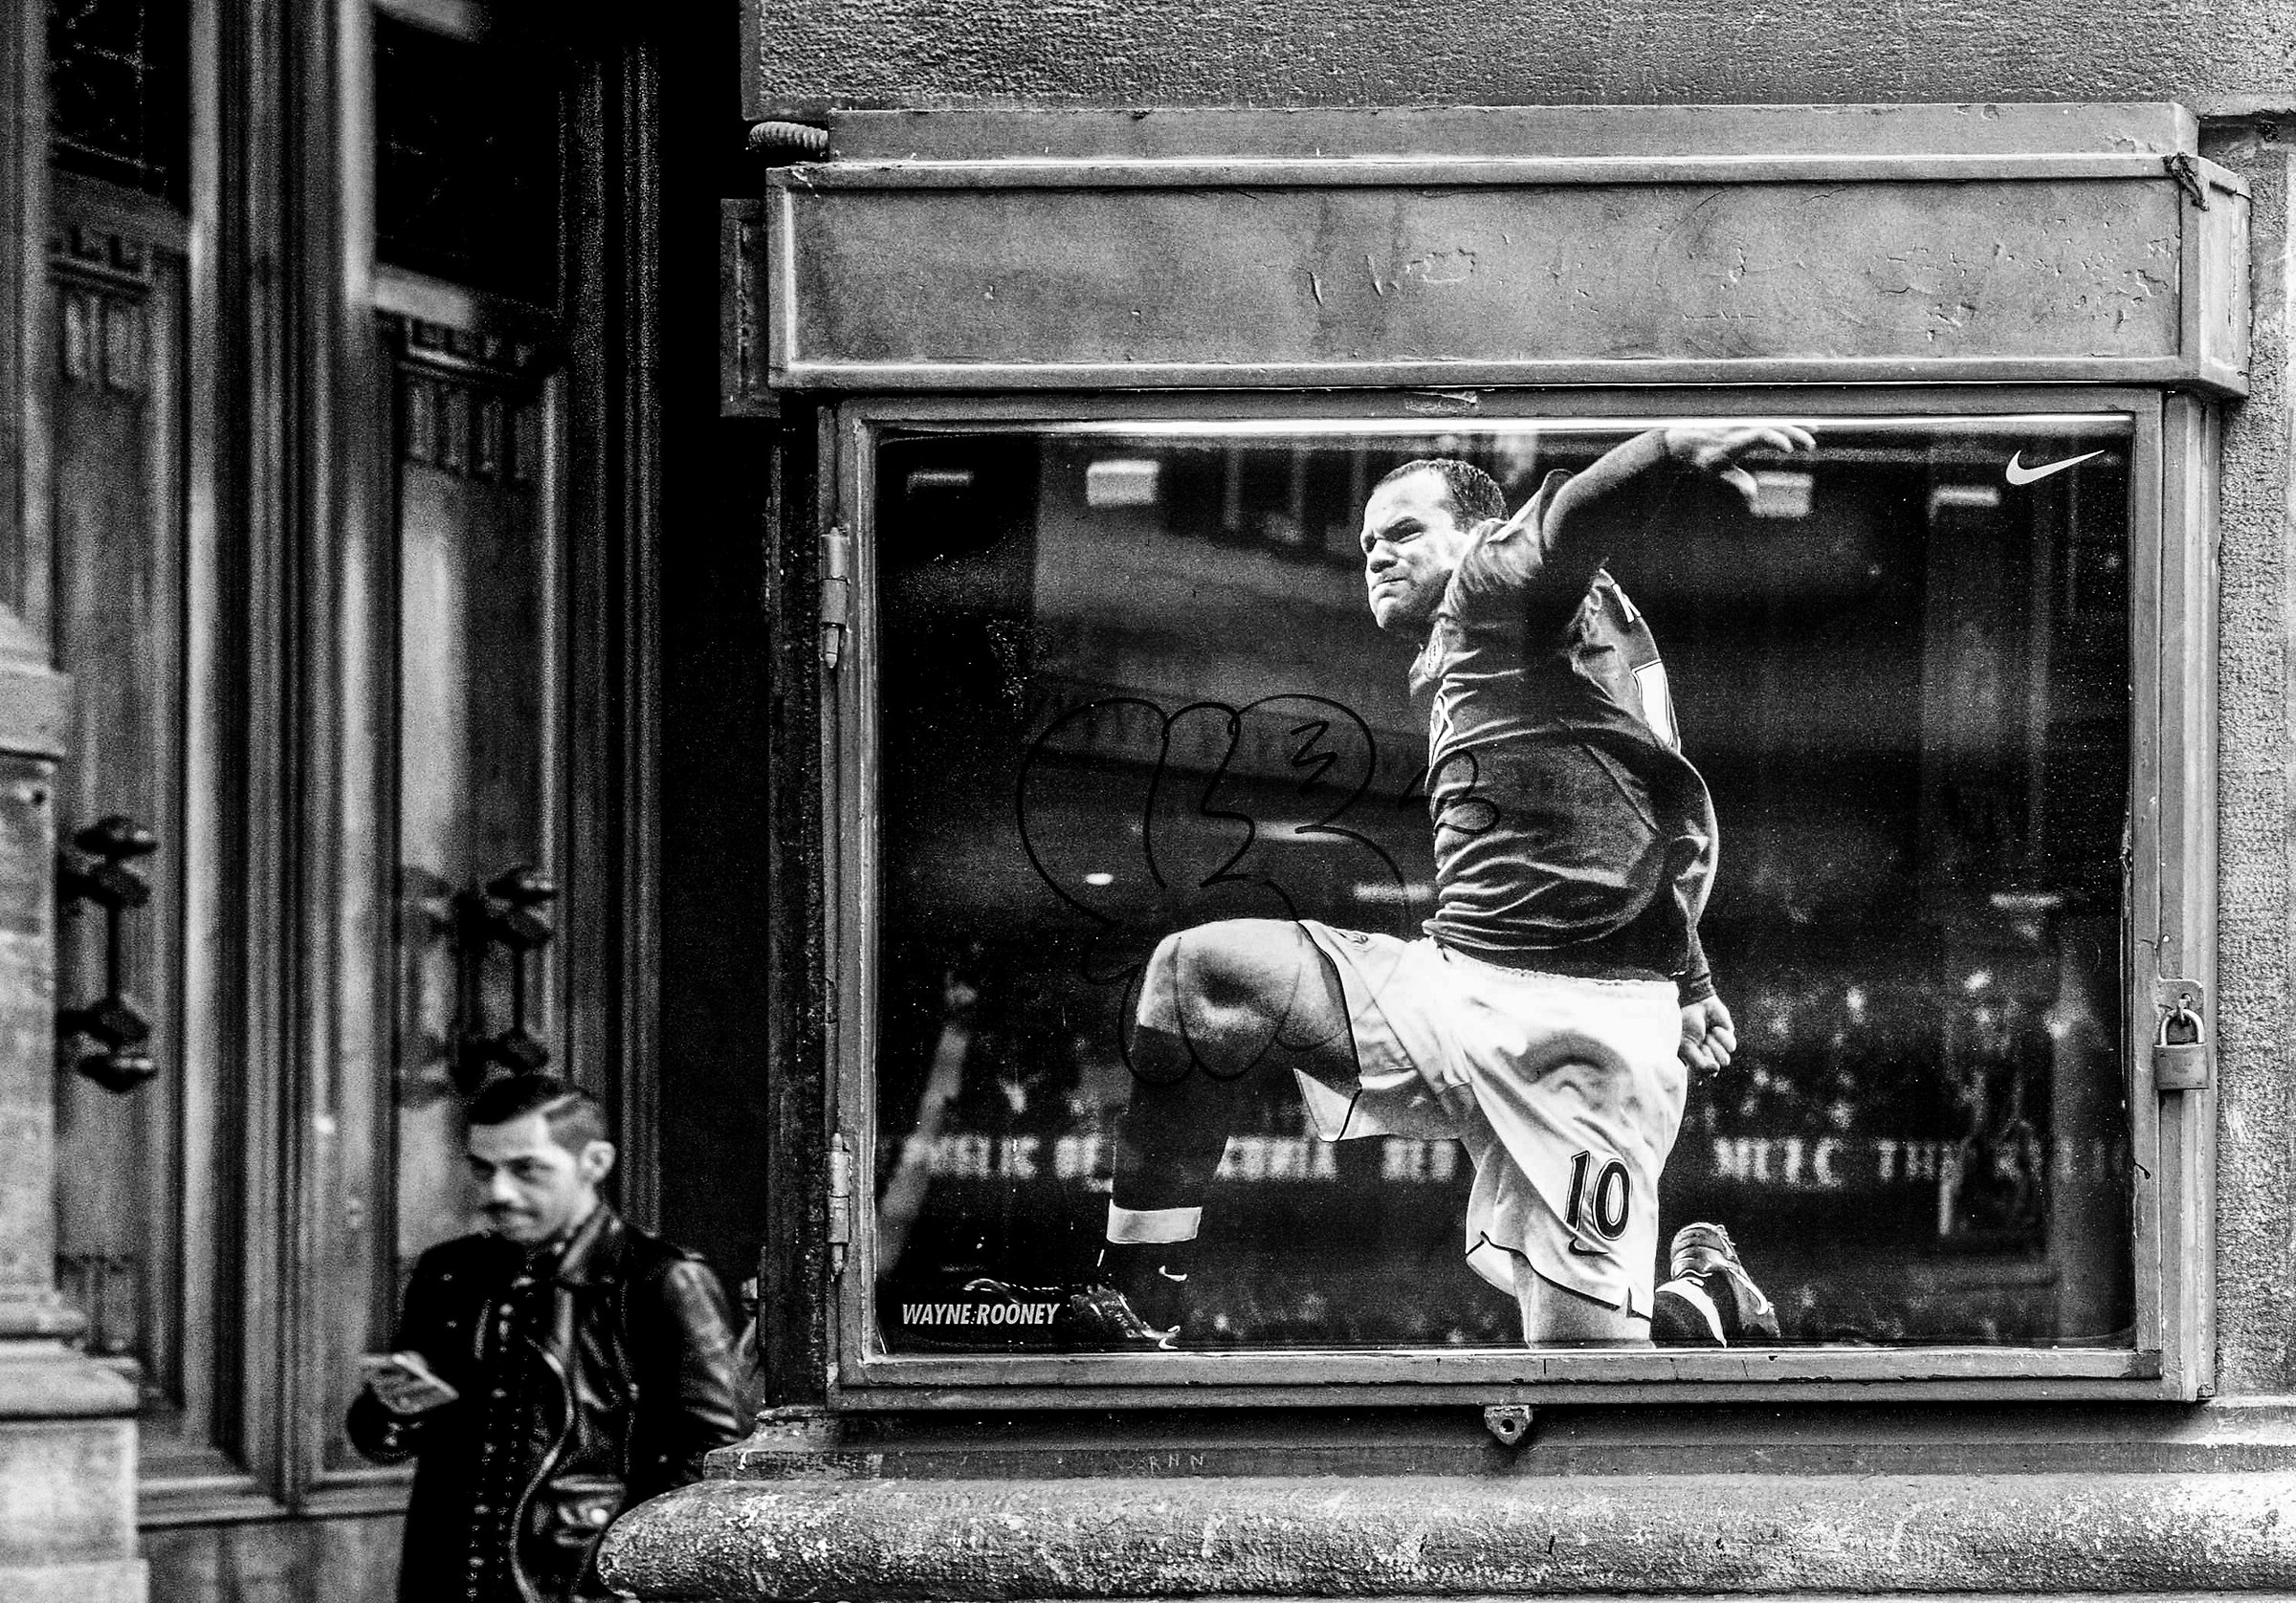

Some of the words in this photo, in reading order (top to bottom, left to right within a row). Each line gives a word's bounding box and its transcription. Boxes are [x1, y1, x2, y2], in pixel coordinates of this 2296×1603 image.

[1564, 1150, 1632, 1241] 10
[902, 1304, 972, 1325] WAYNE
[976, 1303, 1060, 1326] ROONEY
